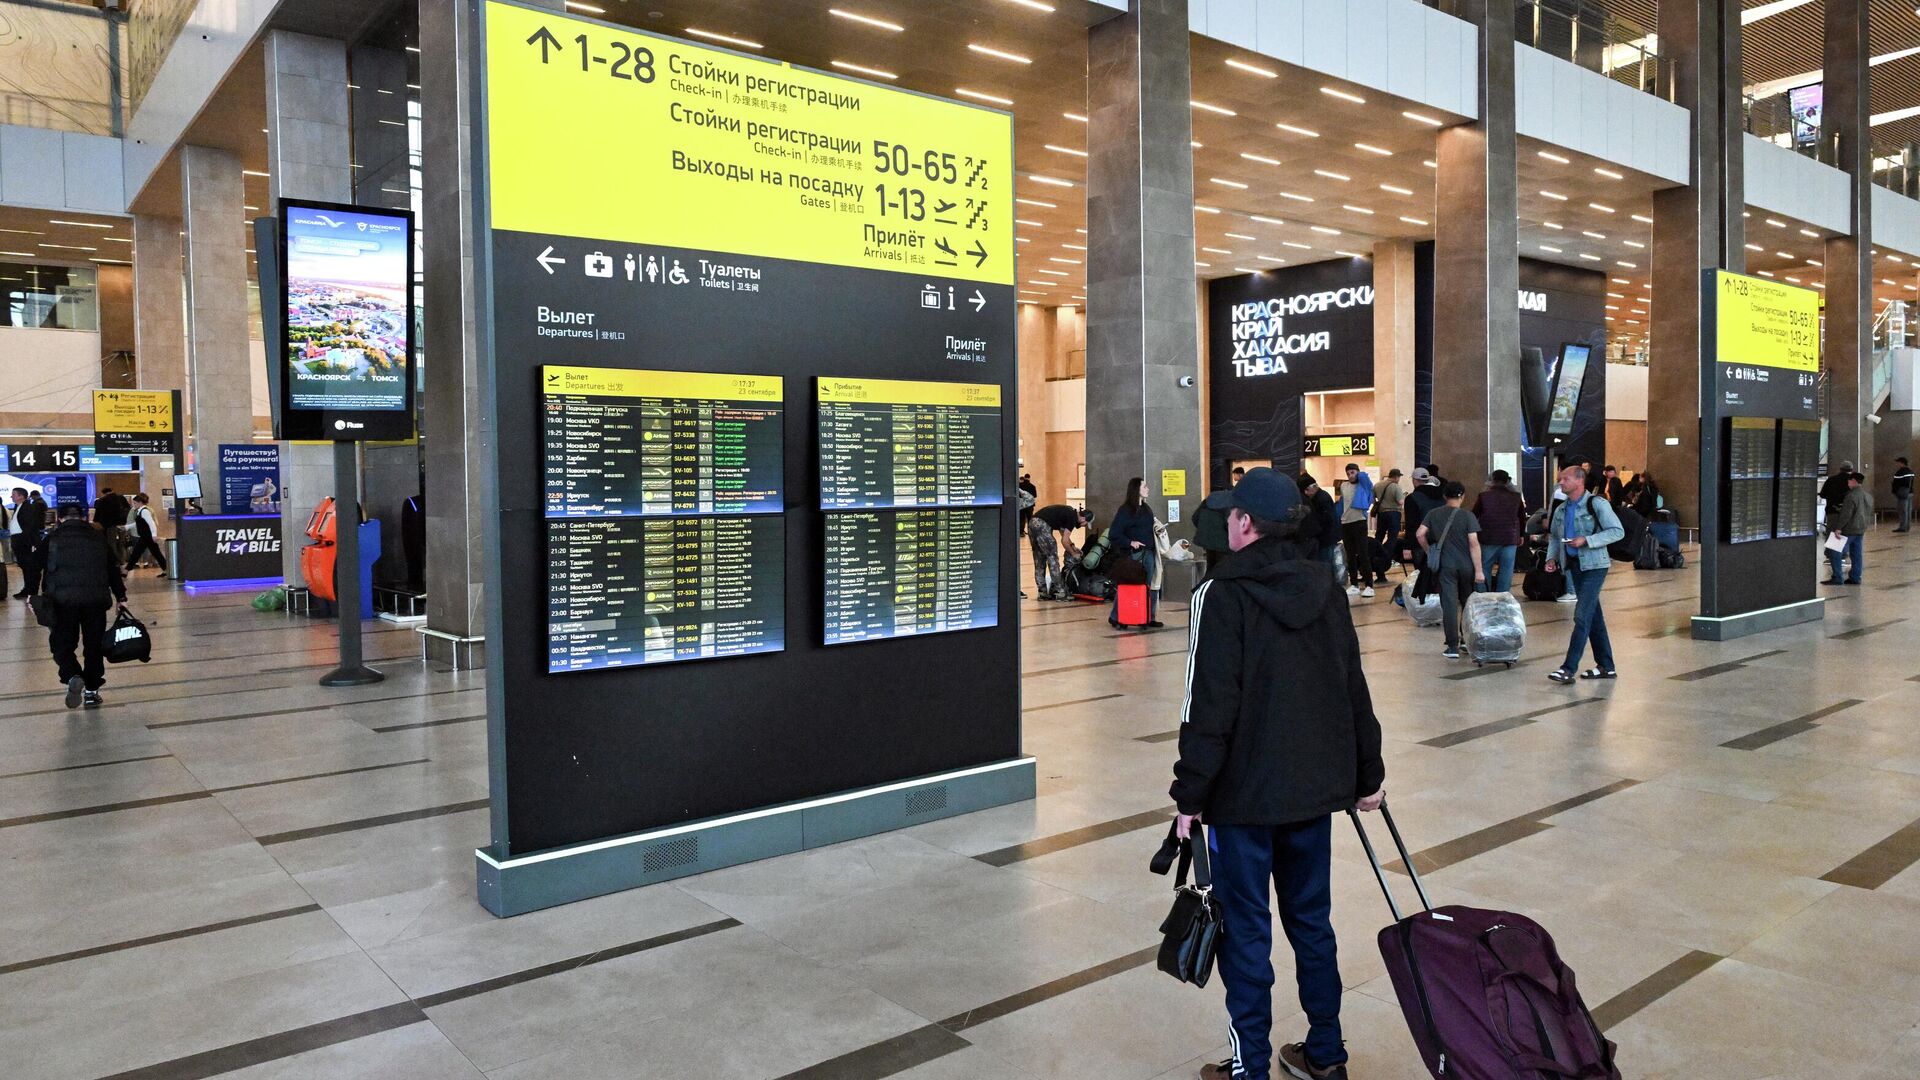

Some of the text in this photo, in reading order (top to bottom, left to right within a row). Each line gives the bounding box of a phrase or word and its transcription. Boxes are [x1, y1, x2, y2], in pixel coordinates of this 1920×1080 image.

[575, 34, 656, 84] 1-28
[669, 53, 860, 111] Стойки регистрации
[670, 79, 722, 100] Check-in
[670, 102, 862, 155] Стойки регистрации
[754, 142, 802, 161] Check-in
[873, 140, 988, 190] 50-65 2
[672, 151, 863, 199] Выходы на посадку
[800, 195, 830, 209] Gates
[840, 201, 865, 215] 登机口
[875, 183, 988, 231] 1-13 3
[864, 224, 925, 249] Прилёт
[864, 246, 902, 261] Arrivals
[699, 259, 761, 280] Туалеты
[699, 278, 730, 289] Toilets
[1733, 279, 1748, 296] 1-28
[537, 306, 595, 324] Вылет
[1789, 310, 1808, 327] 50-65
[537, 326, 593, 339] Departures
[1232, 317, 1283, 340] КРАЙ
[946, 336, 986, 352] Прилёт
[1232, 331, 1330, 359] ХАКАСИЯ
[1790, 330, 1801, 346] 1-13
[946, 352, 971, 361] Arrivals
[1232, 356, 1288, 377] ТЫВА
[565, 373, 588, 381] Вылет
[565, 382, 605, 391] Departures
[748, 388, 776, 396] сентября
[834, 383, 862, 391] Прибытие
[137, 405, 157, 413] 1-13
[224, 449, 276, 457] Путешествуй
[1305, 440, 1318, 452] 27
[1353, 439, 1367, 451] 28
[12, 451, 36, 466] 14
[52, 451, 76, 466] 15
[216, 528, 274, 541] TRAVEL
[115, 626, 142, 642] NIKE
